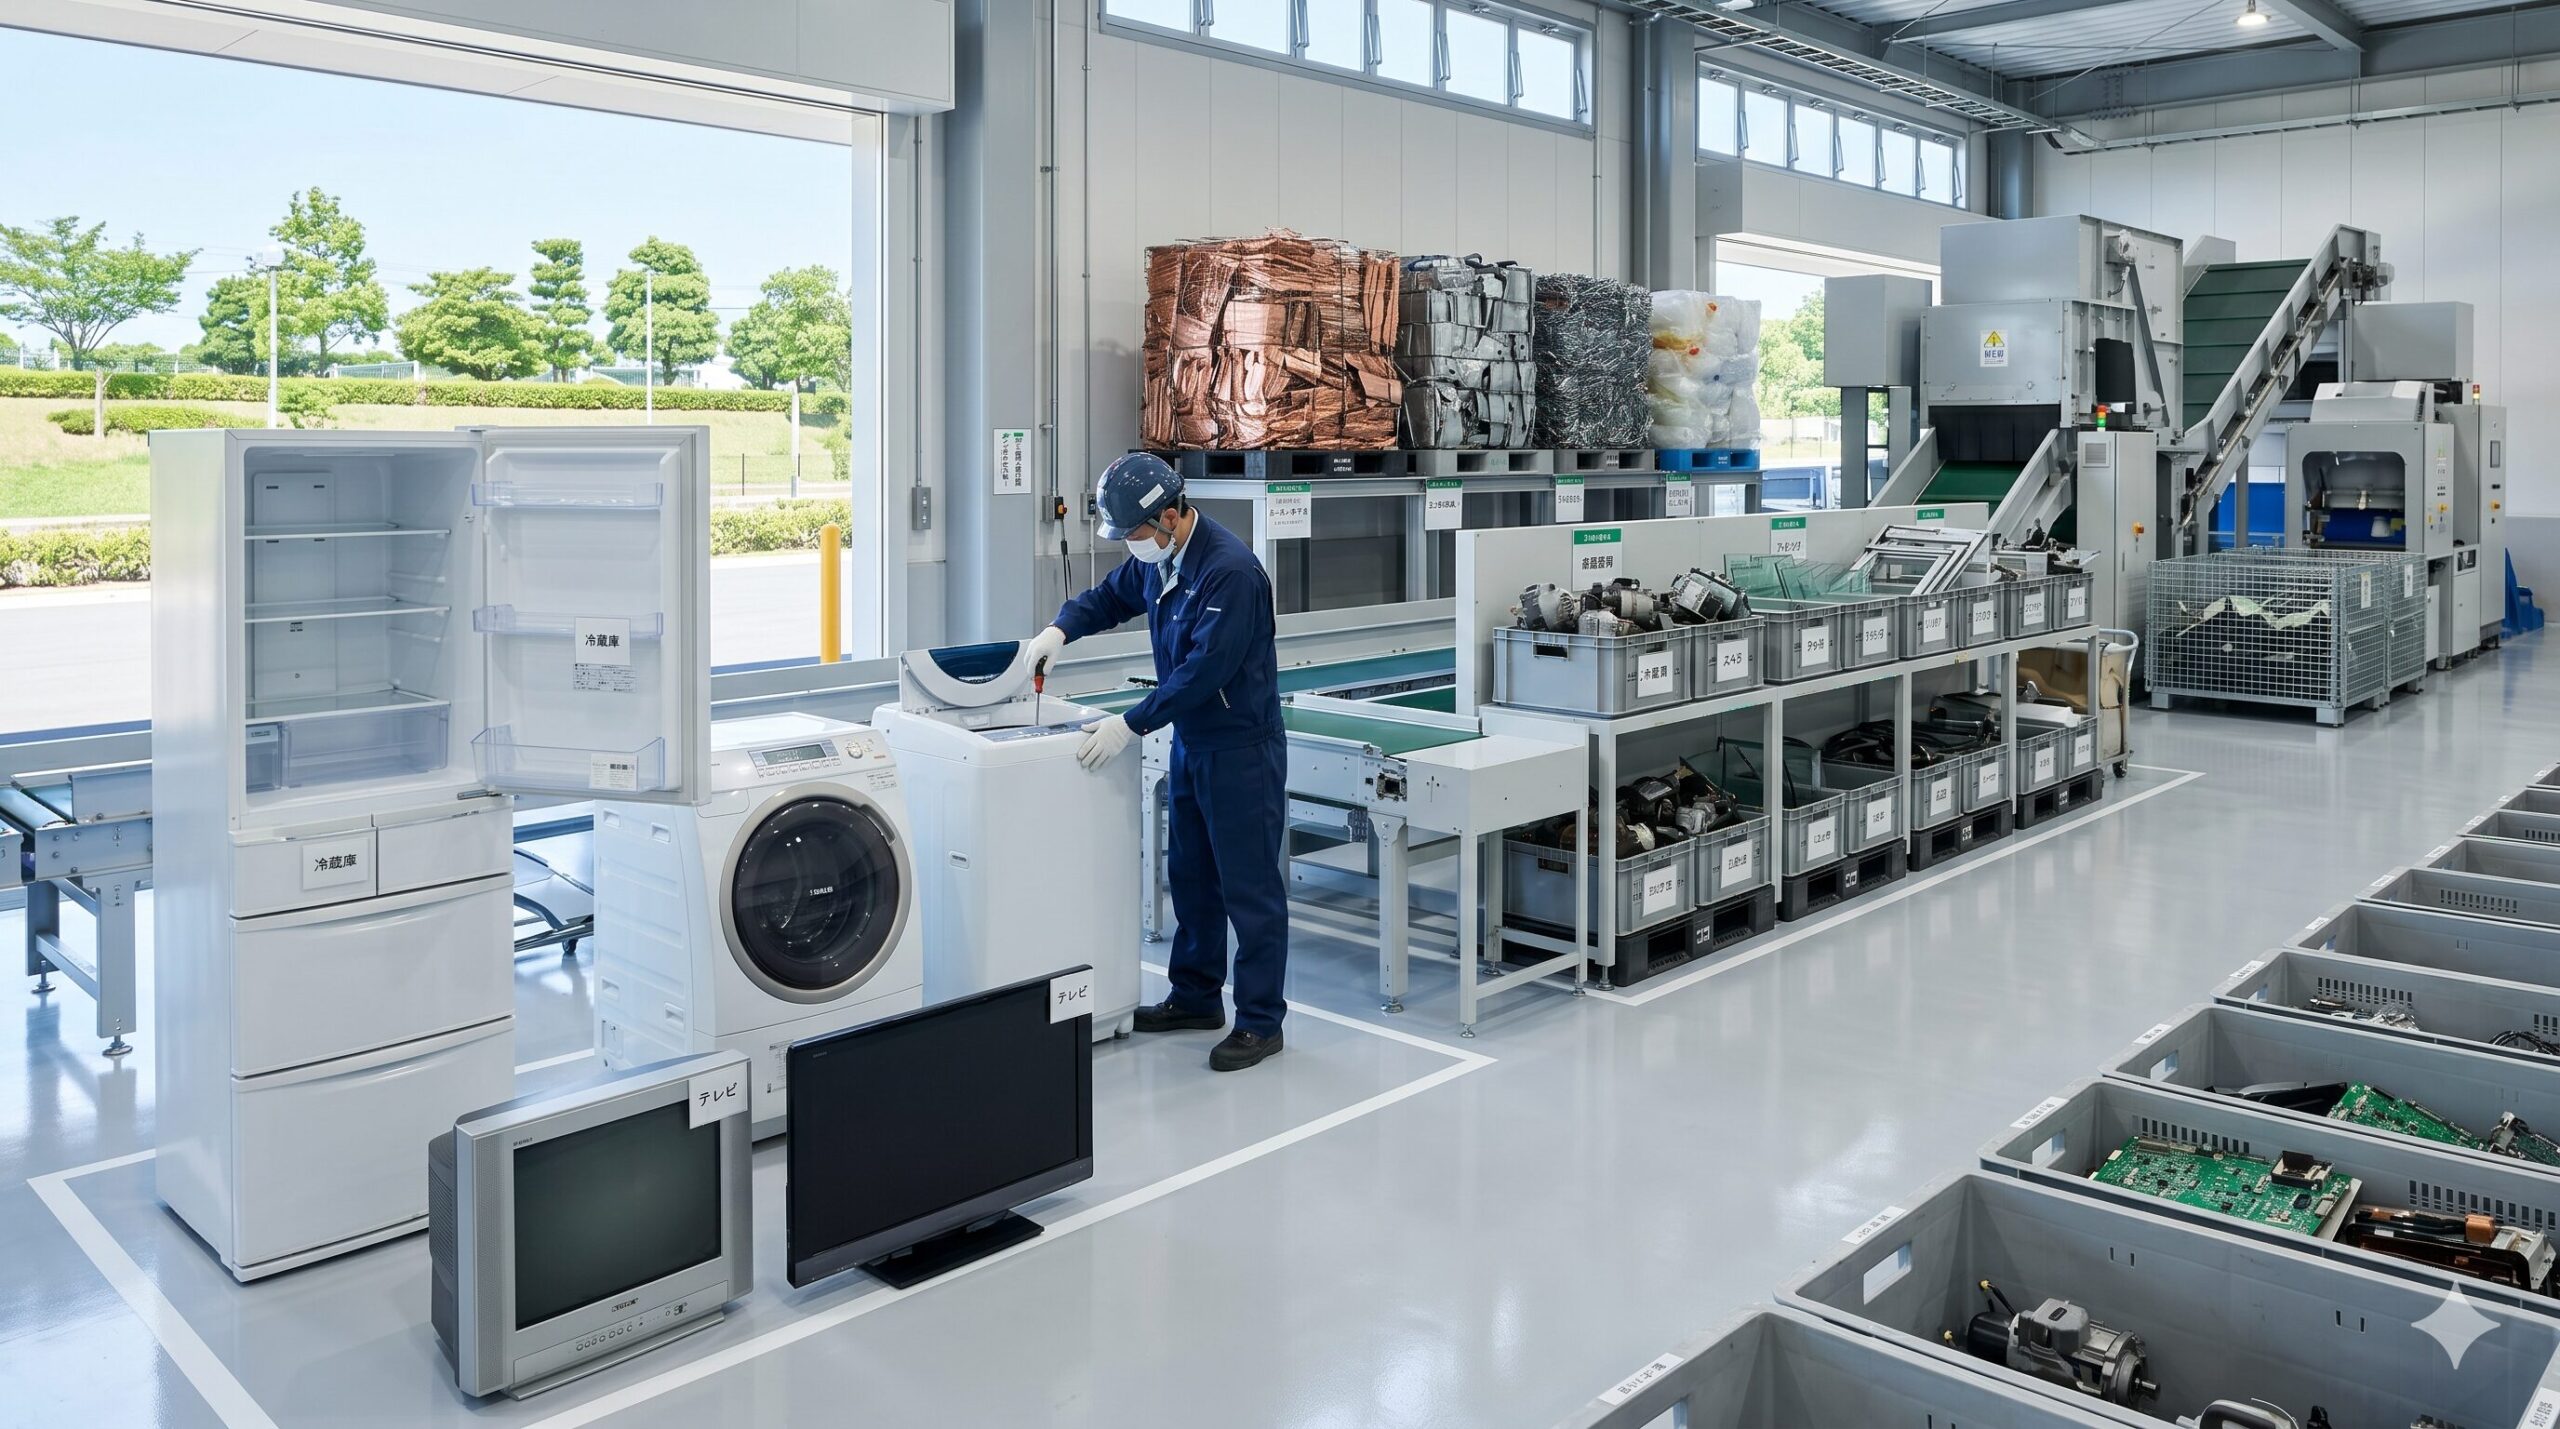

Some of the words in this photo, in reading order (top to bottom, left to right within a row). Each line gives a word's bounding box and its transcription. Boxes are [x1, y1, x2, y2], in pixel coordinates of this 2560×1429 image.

[585, 633, 620, 648] 冷蔵庫
[314, 854, 357, 872] 冷蔵庫
[1057, 985, 1087, 1004] テレビ
[699, 1082, 737, 1106] テレビ
